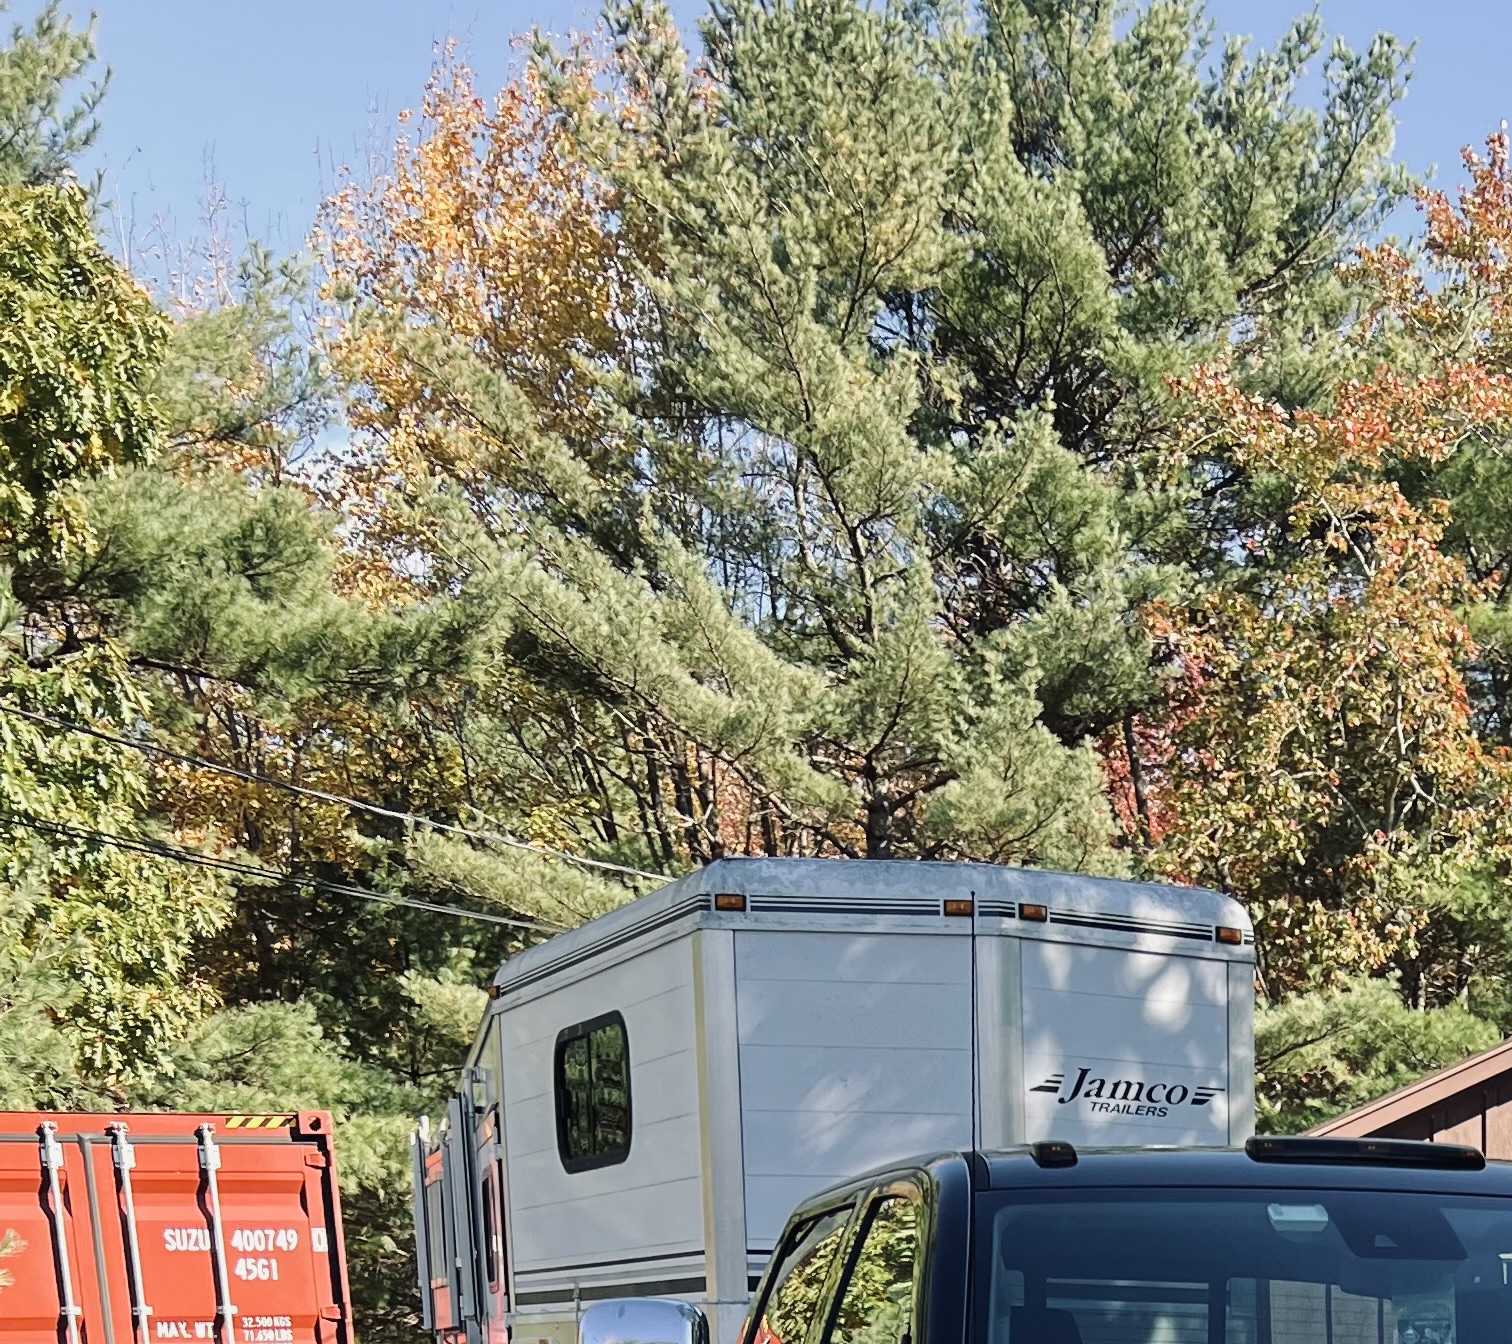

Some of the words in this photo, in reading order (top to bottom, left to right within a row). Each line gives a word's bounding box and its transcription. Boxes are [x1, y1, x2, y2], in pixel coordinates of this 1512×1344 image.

[1058, 1067, 1188, 1105] Jamco
[1090, 1101, 1168, 1117] TRAILERS
[163, 1228, 211, 1251] SUZU
[231, 1229, 298, 1252] 400749
[234, 1258, 279, 1281] 45G1
[273, 1316, 292, 1328] KGS
[275, 1329, 293, 1341] LBS
